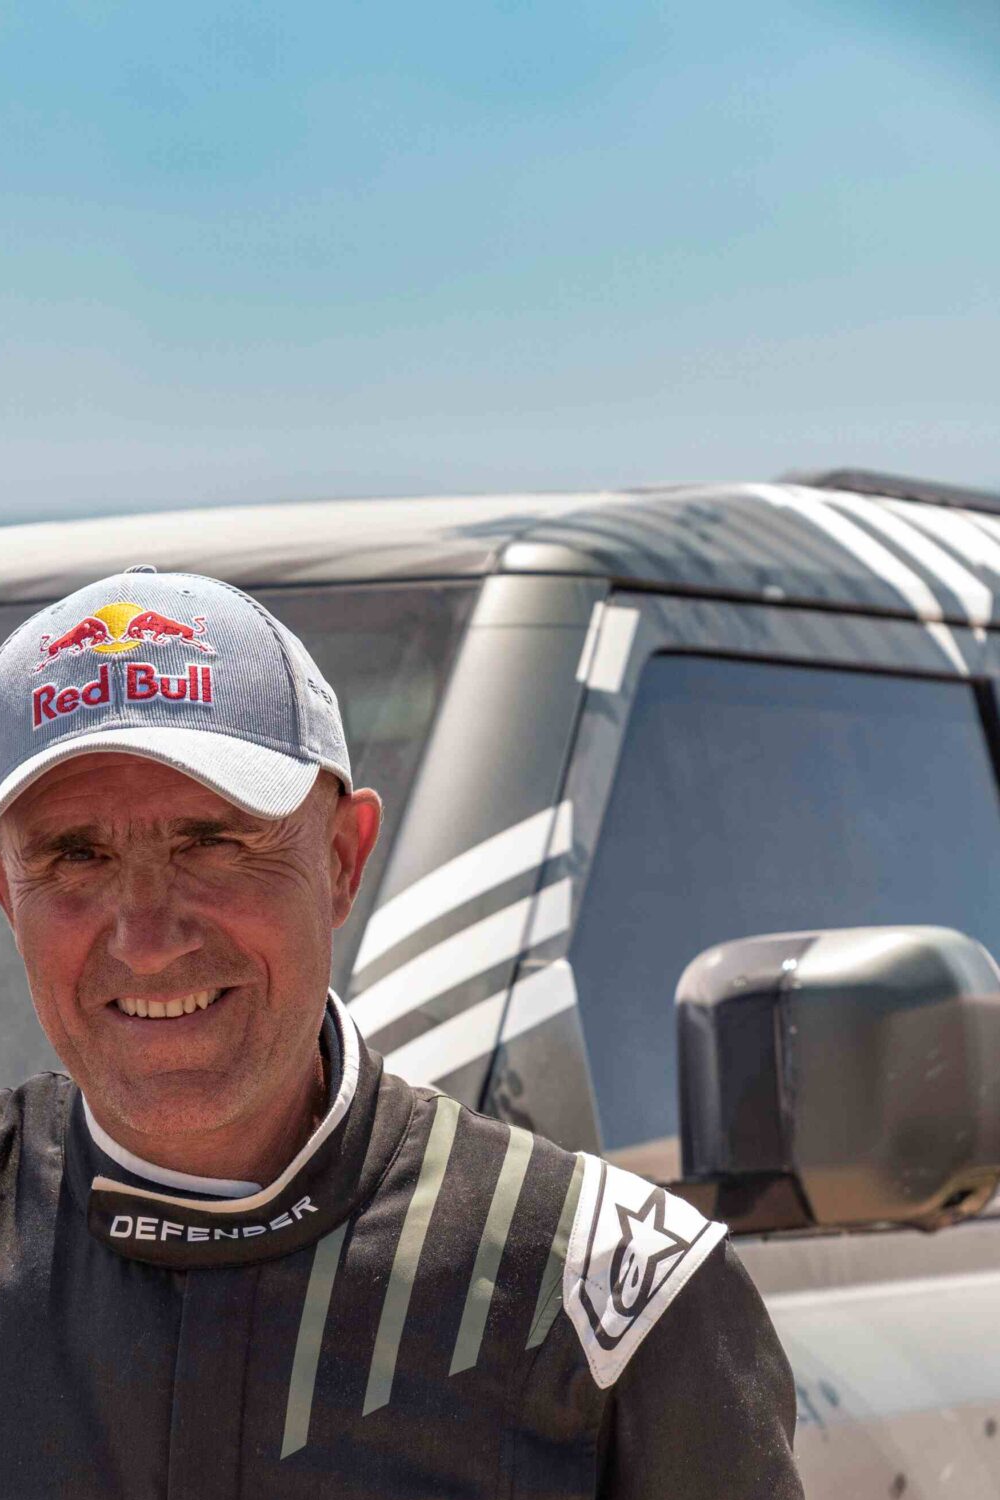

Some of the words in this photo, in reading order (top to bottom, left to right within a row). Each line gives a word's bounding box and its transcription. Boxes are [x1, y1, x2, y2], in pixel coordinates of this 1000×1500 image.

[32, 663, 111, 731] Red
[125, 662, 213, 706] Bull
[109, 1195, 319, 1242] DEFENDER
